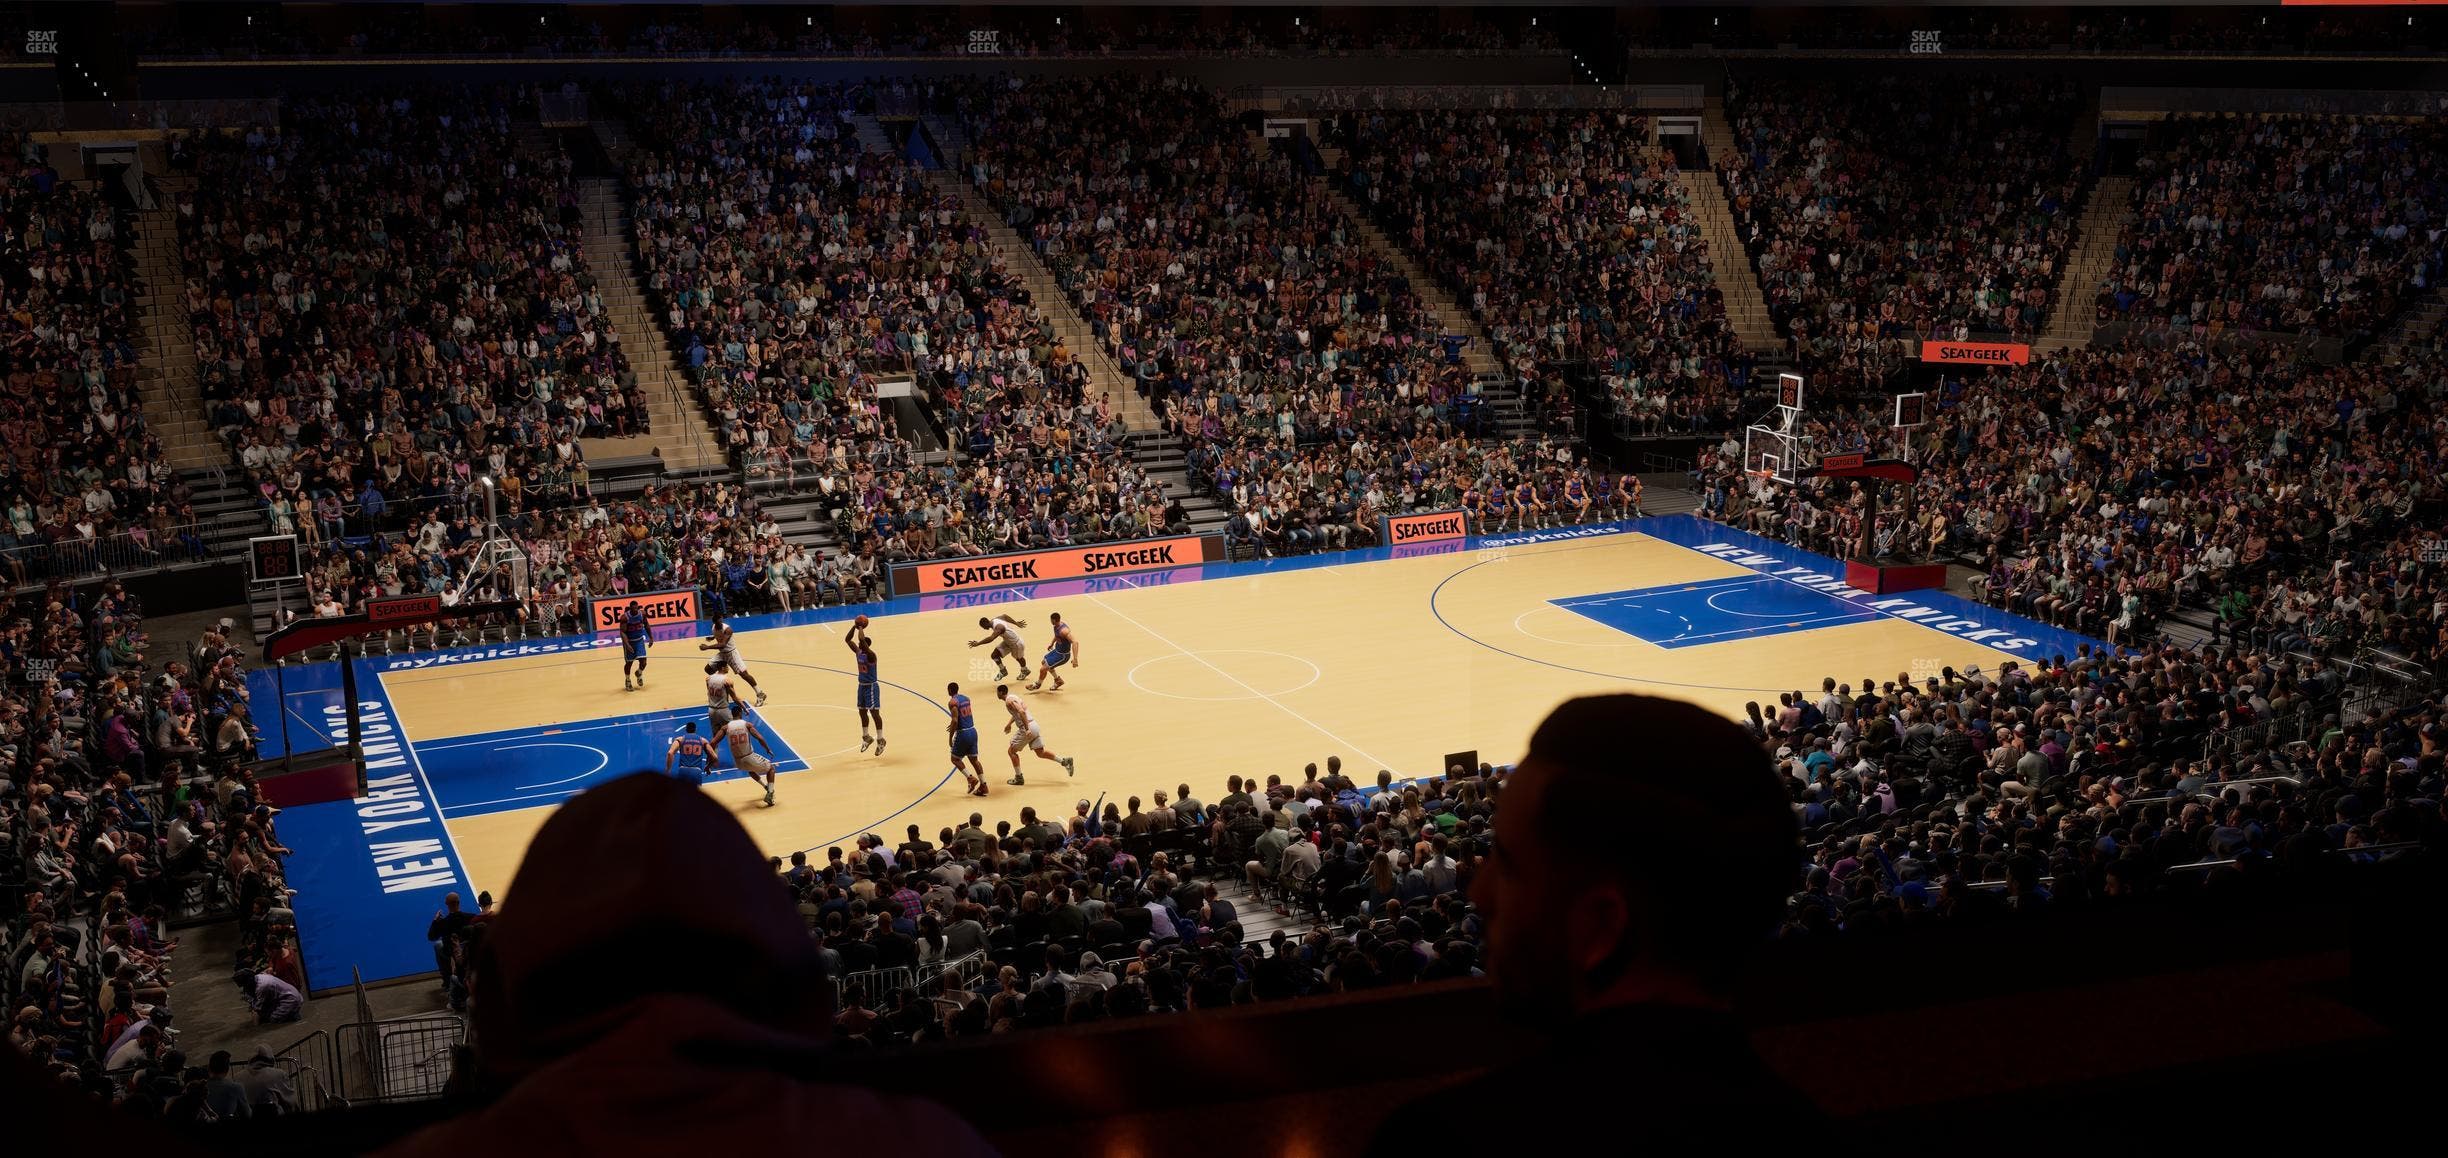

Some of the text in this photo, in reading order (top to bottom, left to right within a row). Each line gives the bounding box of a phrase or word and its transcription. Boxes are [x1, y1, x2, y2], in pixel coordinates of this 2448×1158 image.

[1940, 346, 2011, 362] SEATGEEK
[1395, 517, 1462, 540] SEATGEEK
[1483, 527, 1621, 547] @nyknicks
[942, 559, 1038, 587] SEATGEEK
[1083, 545, 1175, 573] SEATGEEK
[1692, 543, 2039, 650] NEW YORK KNICKS
[601, 598, 691, 626] SEGEEK
[353, 772, 431, 835] YORK
[369, 838, 458, 894] NEW
